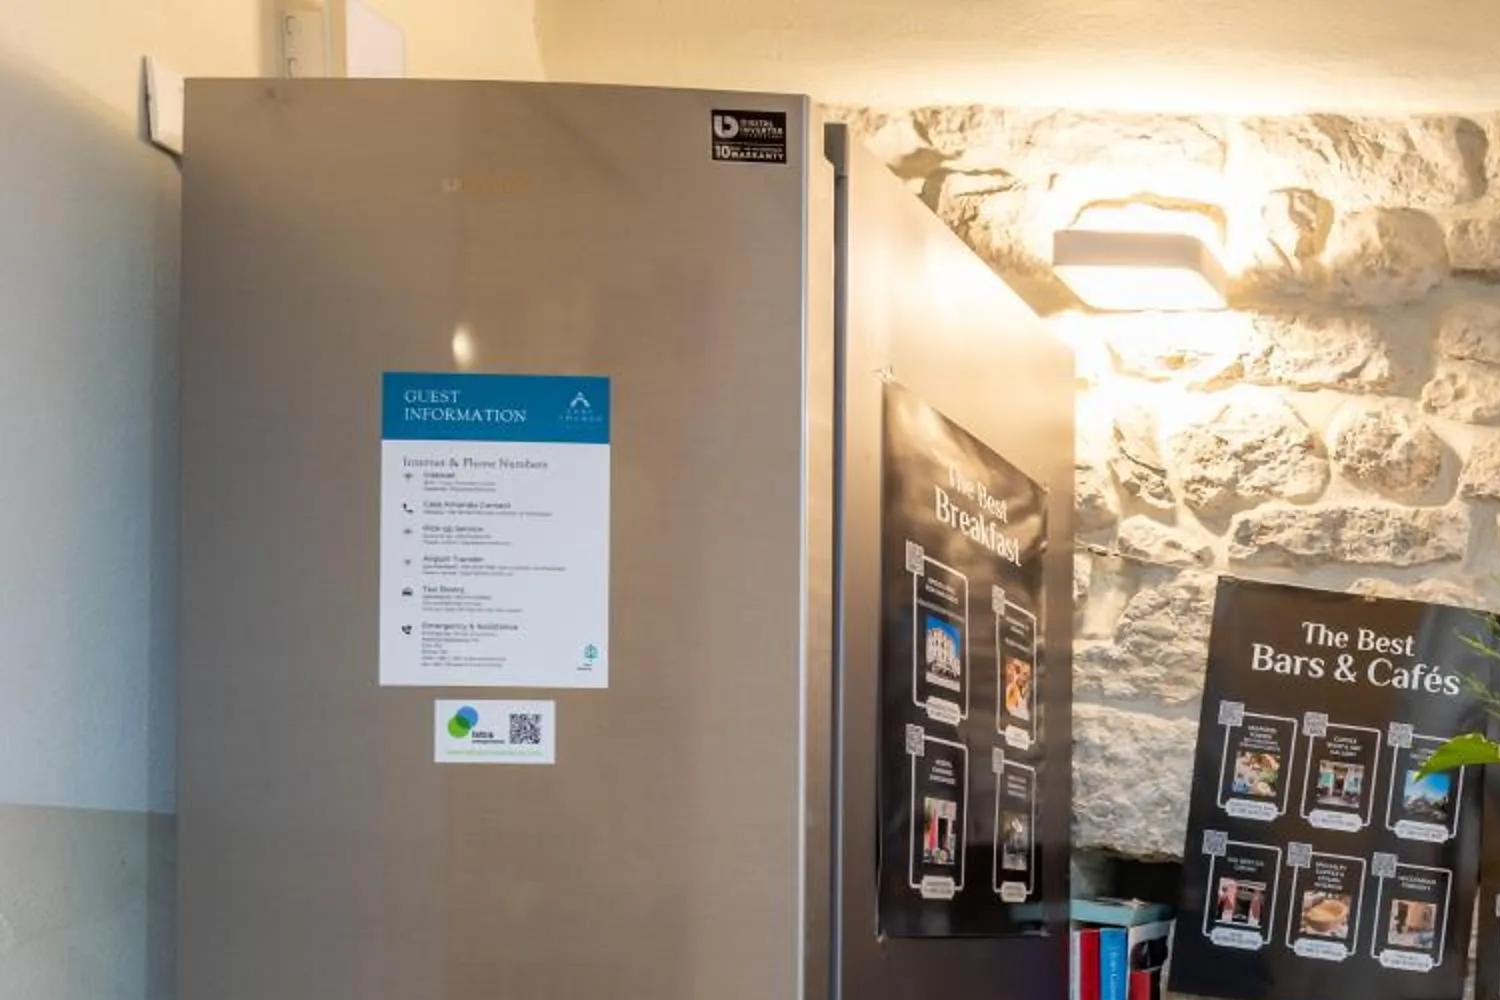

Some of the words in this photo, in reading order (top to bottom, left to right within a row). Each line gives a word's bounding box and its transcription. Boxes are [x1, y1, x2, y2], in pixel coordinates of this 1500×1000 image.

[403, 389, 462, 404] GUEST
[404, 407, 528, 423] INFORMATION
[500, 457, 549, 470] Numbers
[948, 463, 975, 500] The
[976, 481, 1008, 524] Best
[934, 485, 1022, 567] Breakfast
[1302, 621, 1349, 648] The
[1357, 628, 1416, 658] Best
[1251, 642, 1326, 679] Bars
[1333, 654, 1358, 683] &
[1366, 657, 1461, 696] Cafés
